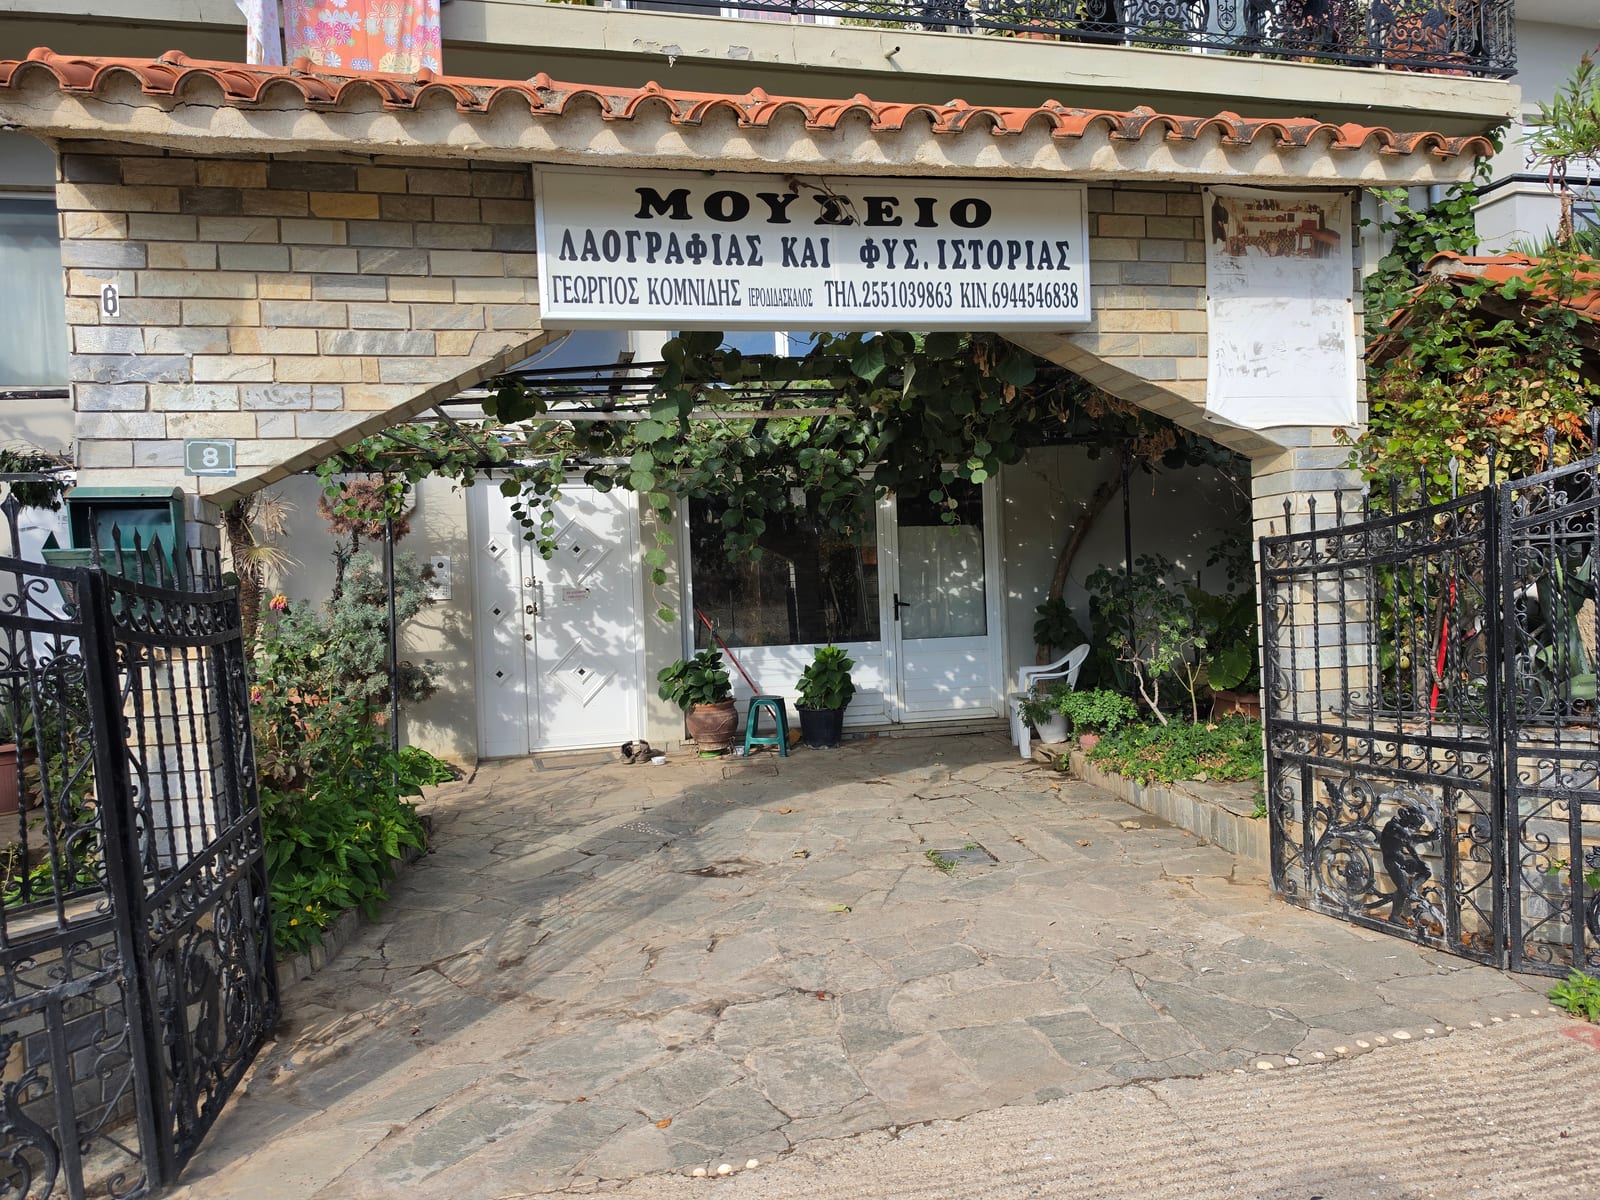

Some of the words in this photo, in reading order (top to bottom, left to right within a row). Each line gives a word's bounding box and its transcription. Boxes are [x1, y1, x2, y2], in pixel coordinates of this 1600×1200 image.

[634, 187, 992, 228] ΜΟΥΣΕΙΟ
[559, 229, 763, 266] ΛΑΟΓΡΑΦΙΑΣ
[781, 236, 831, 268] ΚΑΙ
[102, 287, 118, 314] 6
[552, 275, 639, 305] ΓΕΩΡΓΙΟΣ
[647, 278, 742, 306] ΚΟΜΝΙΔΗΣ
[748, 287, 813, 307] ΙΕΡΟΔΙΔΑΣΚΑΛΟΣ
[202, 447, 219, 467] 8
